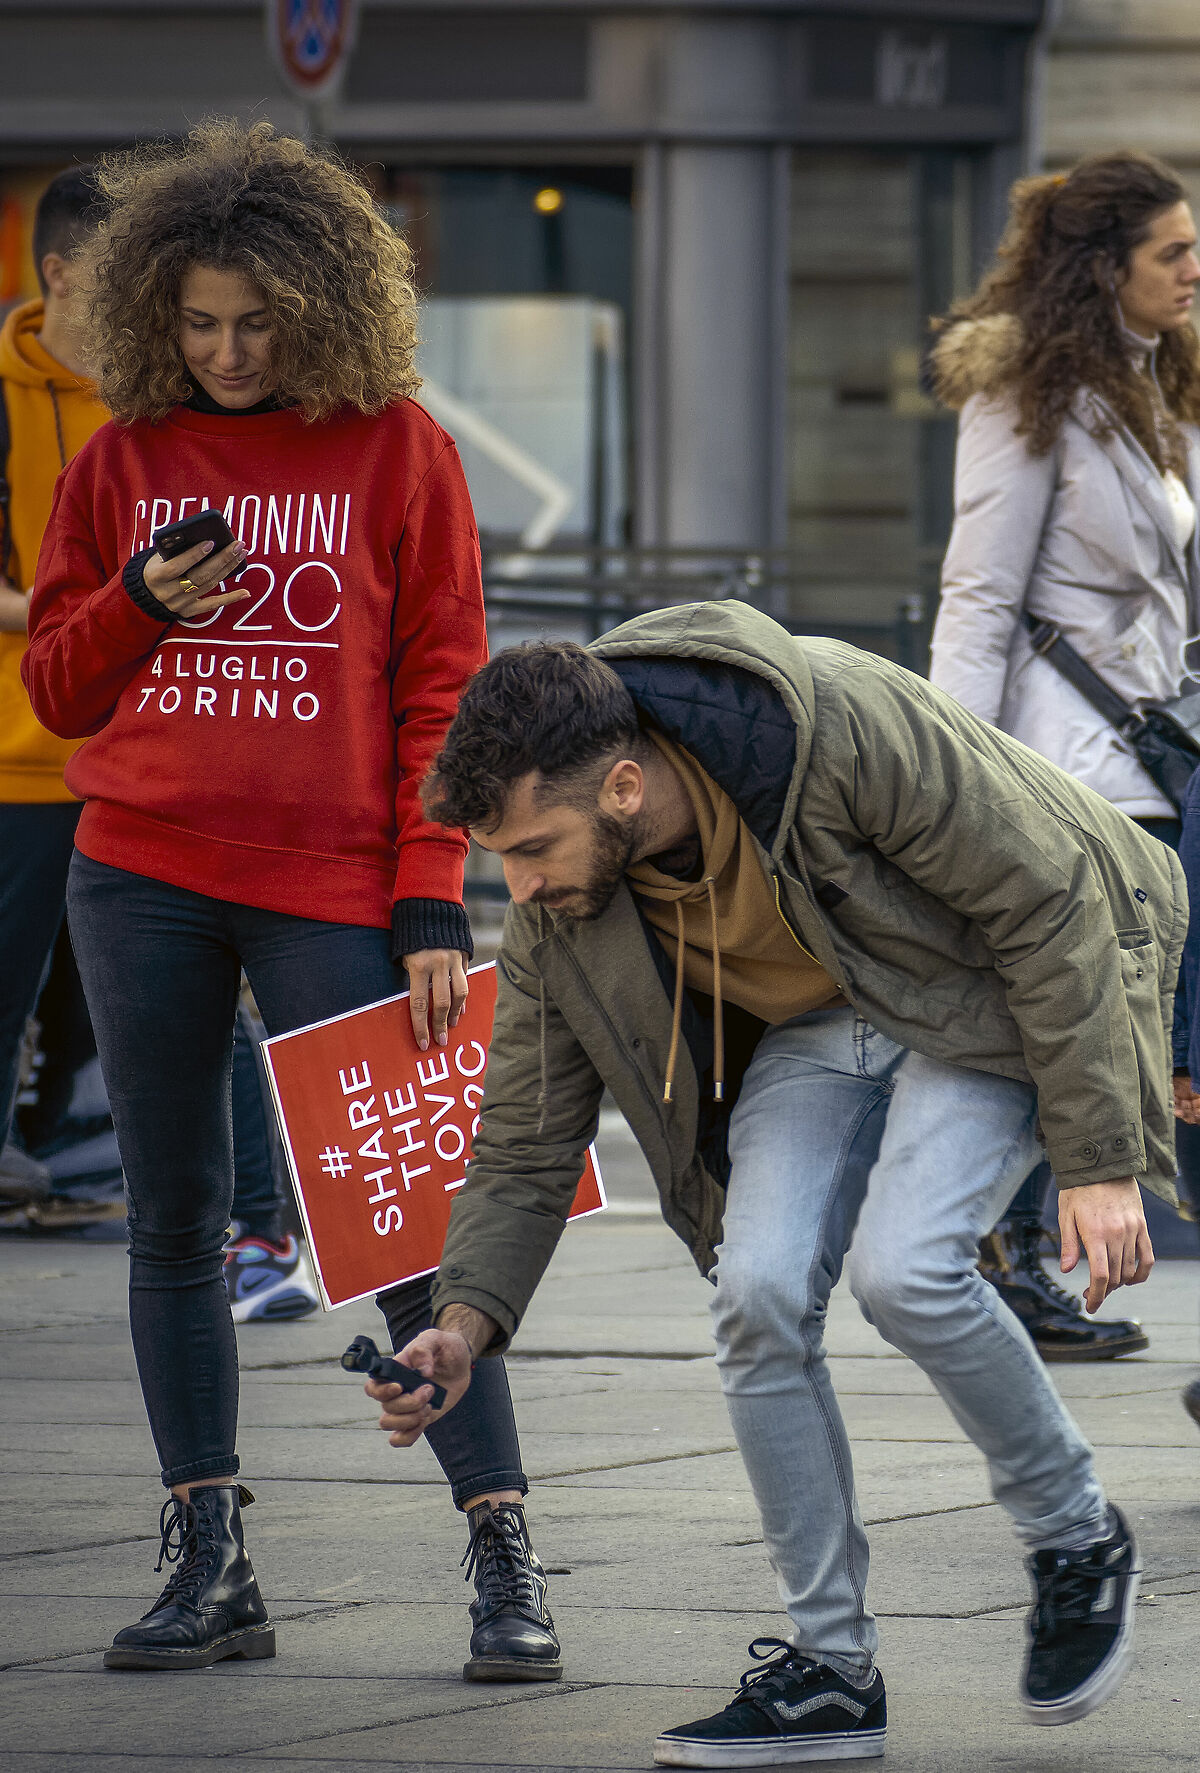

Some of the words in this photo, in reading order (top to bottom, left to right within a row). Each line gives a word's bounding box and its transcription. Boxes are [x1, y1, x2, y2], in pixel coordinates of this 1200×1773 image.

[151, 654, 163, 679] 4
[175, 653, 308, 682] LUGLIO
[136, 685, 320, 721] TORINO
[338, 1060, 404, 1237] SHARE
[383, 1082, 432, 1192] THE
[318, 1145, 353, 1179] #
